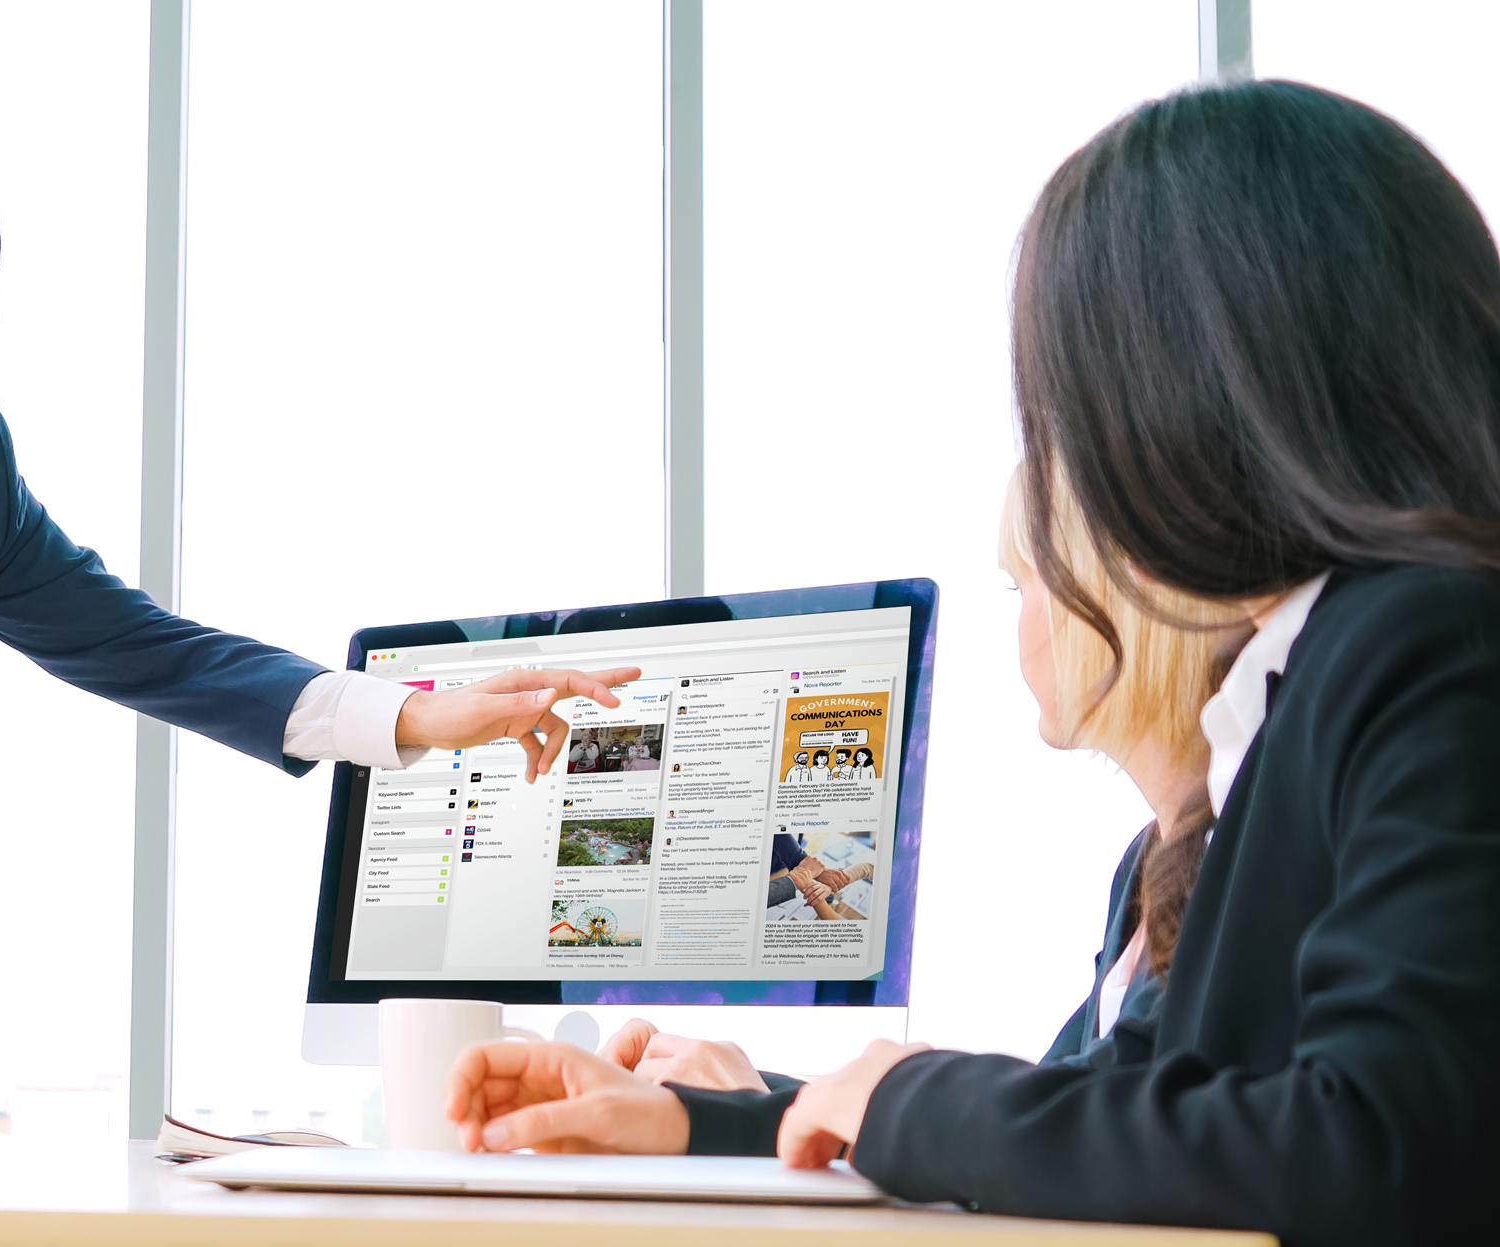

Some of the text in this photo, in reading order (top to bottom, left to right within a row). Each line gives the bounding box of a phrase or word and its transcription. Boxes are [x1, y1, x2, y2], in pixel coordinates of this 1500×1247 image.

[800, 698, 876, 712] GOVERNMENT
[791, 709, 882, 721] COMMUNICATIONS
[825, 720, 846, 728] DAY
